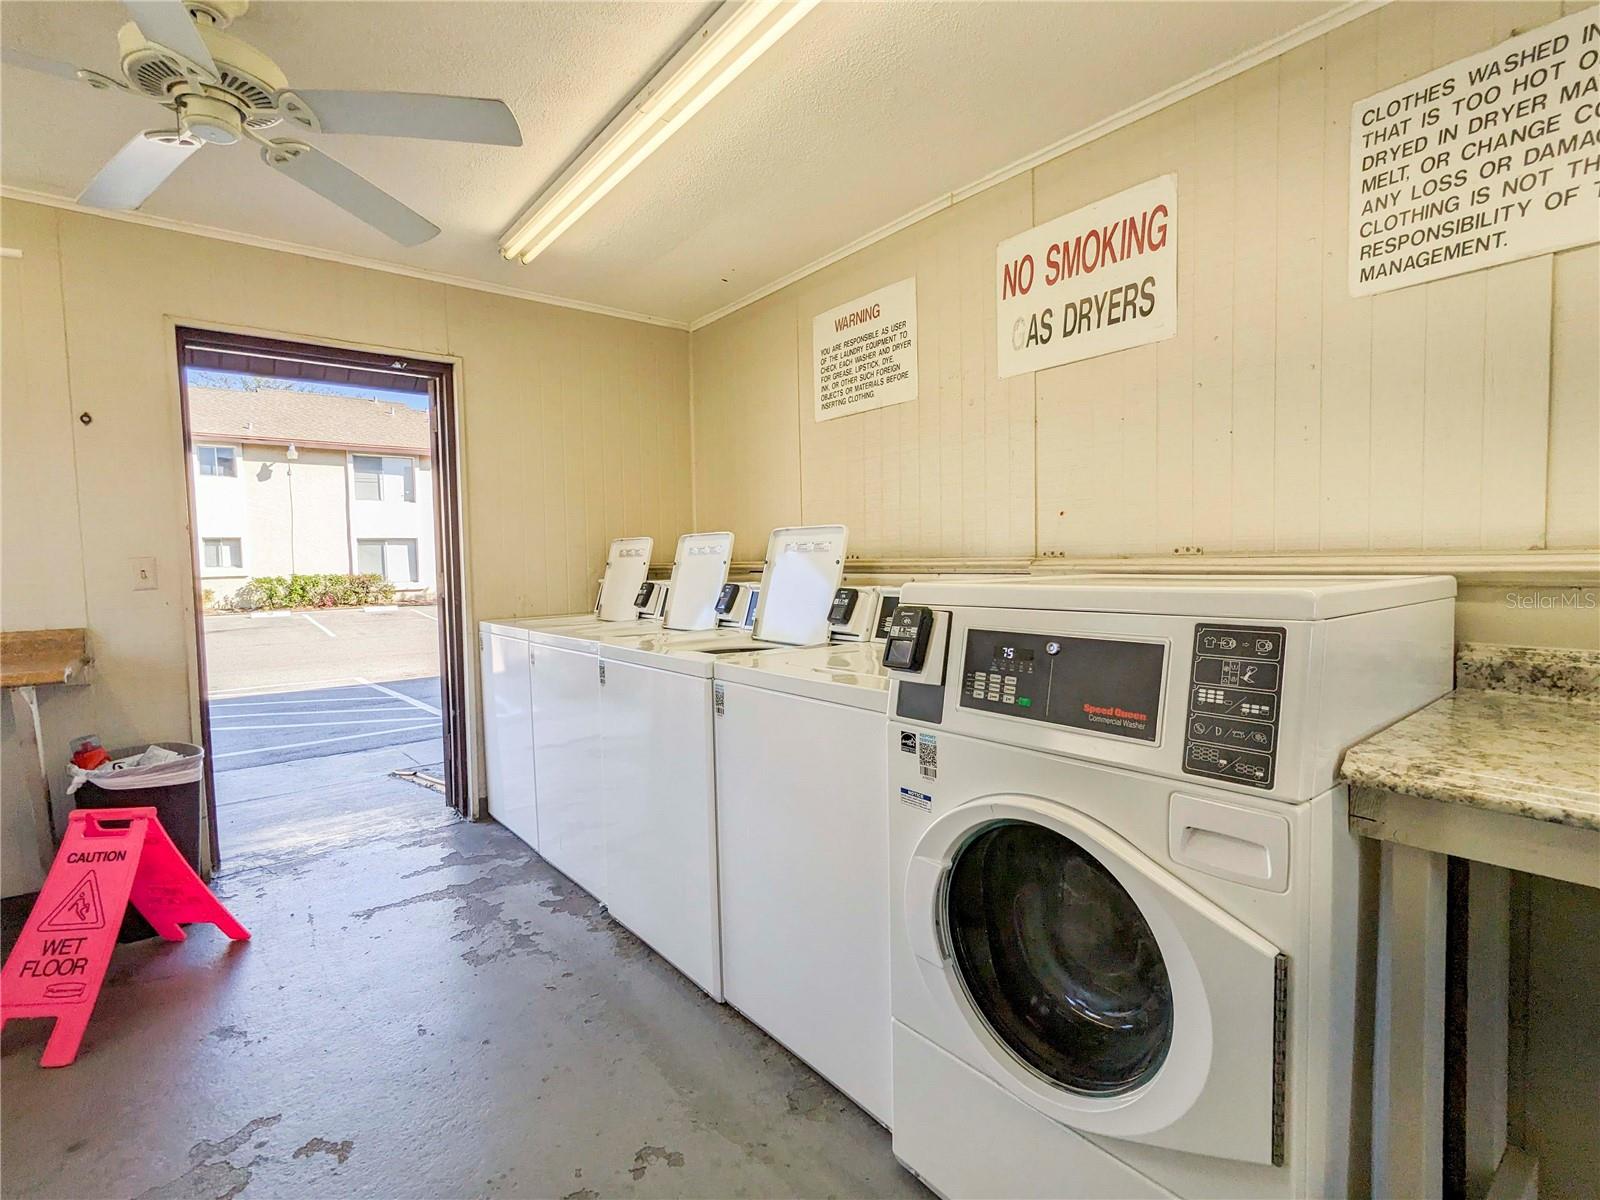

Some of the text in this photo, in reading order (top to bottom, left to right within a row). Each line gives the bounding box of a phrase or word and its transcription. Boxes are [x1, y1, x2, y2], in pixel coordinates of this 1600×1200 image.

[1361, 78, 1456, 127] CLOTHES
[1468, 34, 1570, 86] WASHED
[1362, 50, 1600, 148] THAT IS TOO HOT O
[1362, 76, 1600, 172] DRYED IN DRYER MA
[1361, 164, 1410, 195] MELT,
[1420, 151, 1450, 175] OR
[1460, 114, 1562, 162] CHANGE
[1361, 129, 1600, 217] ANY LOSS OR DAMA
[1359, 195, 1460, 239] CLOTHING
[1470, 186, 1491, 207] IS
[1501, 168, 1554, 198] NOT
[1359, 199, 1533, 261] RESPONSIBILITY
[1544, 186, 1581, 211] OF
[1002, 204, 1169, 301] NO SMOKING
[1359, 230, 1508, 283] MANAGEMENT.
[834, 303, 881, 333] WARNING
[1062, 276, 1156, 339] DRYERS
[820, 320, 907, 356] YOU ARE RESPONSIBLE AS USER
[820, 330, 908, 366] OF THE LAUNDRY EQUIPMENT TO
[820, 339, 912, 375] CHECK EACH WASHER AND DRYER
[820, 374, 831, 384] FOR
[820, 370, 909, 402] OBJECTS OR MATERIALS BEFORE
[832, 381, 839, 390] OR
[840, 376, 858, 387] OTHER
[859, 371, 875, 381] SUCH
[875, 363, 901, 377] FOREIGN
[821, 397, 846, 411] INSERTING
[1002, 647, 1015, 659] 75
[1083, 703, 1147, 721] Speed Queen
[1088, 714, 1146, 730] Commercial Washer
[66, 850, 127, 864] CAUTION
[42, 937, 88, 956] WET
[19, 957, 89, 978] FLOOR
